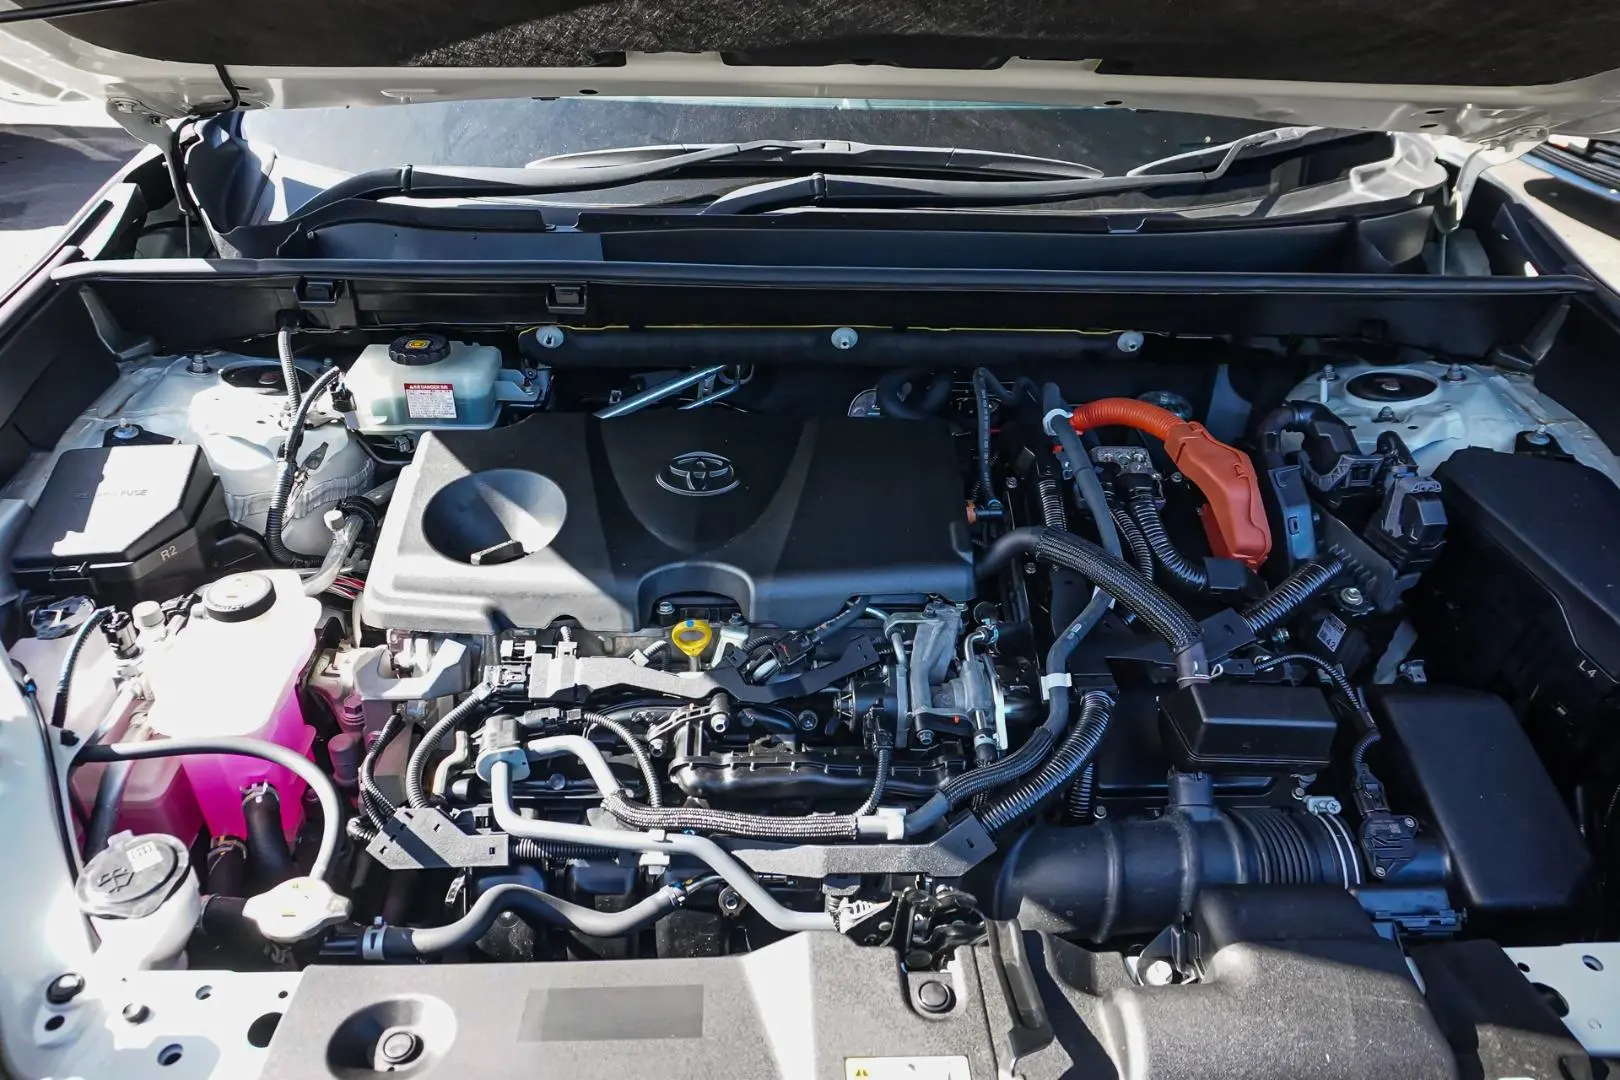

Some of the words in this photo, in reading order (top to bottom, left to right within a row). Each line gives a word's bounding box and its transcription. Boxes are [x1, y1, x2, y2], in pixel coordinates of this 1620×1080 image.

[120, 489, 148, 497] FUSE
[160, 545, 178, 561] R2
[1578, 659, 1597, 678] L4
